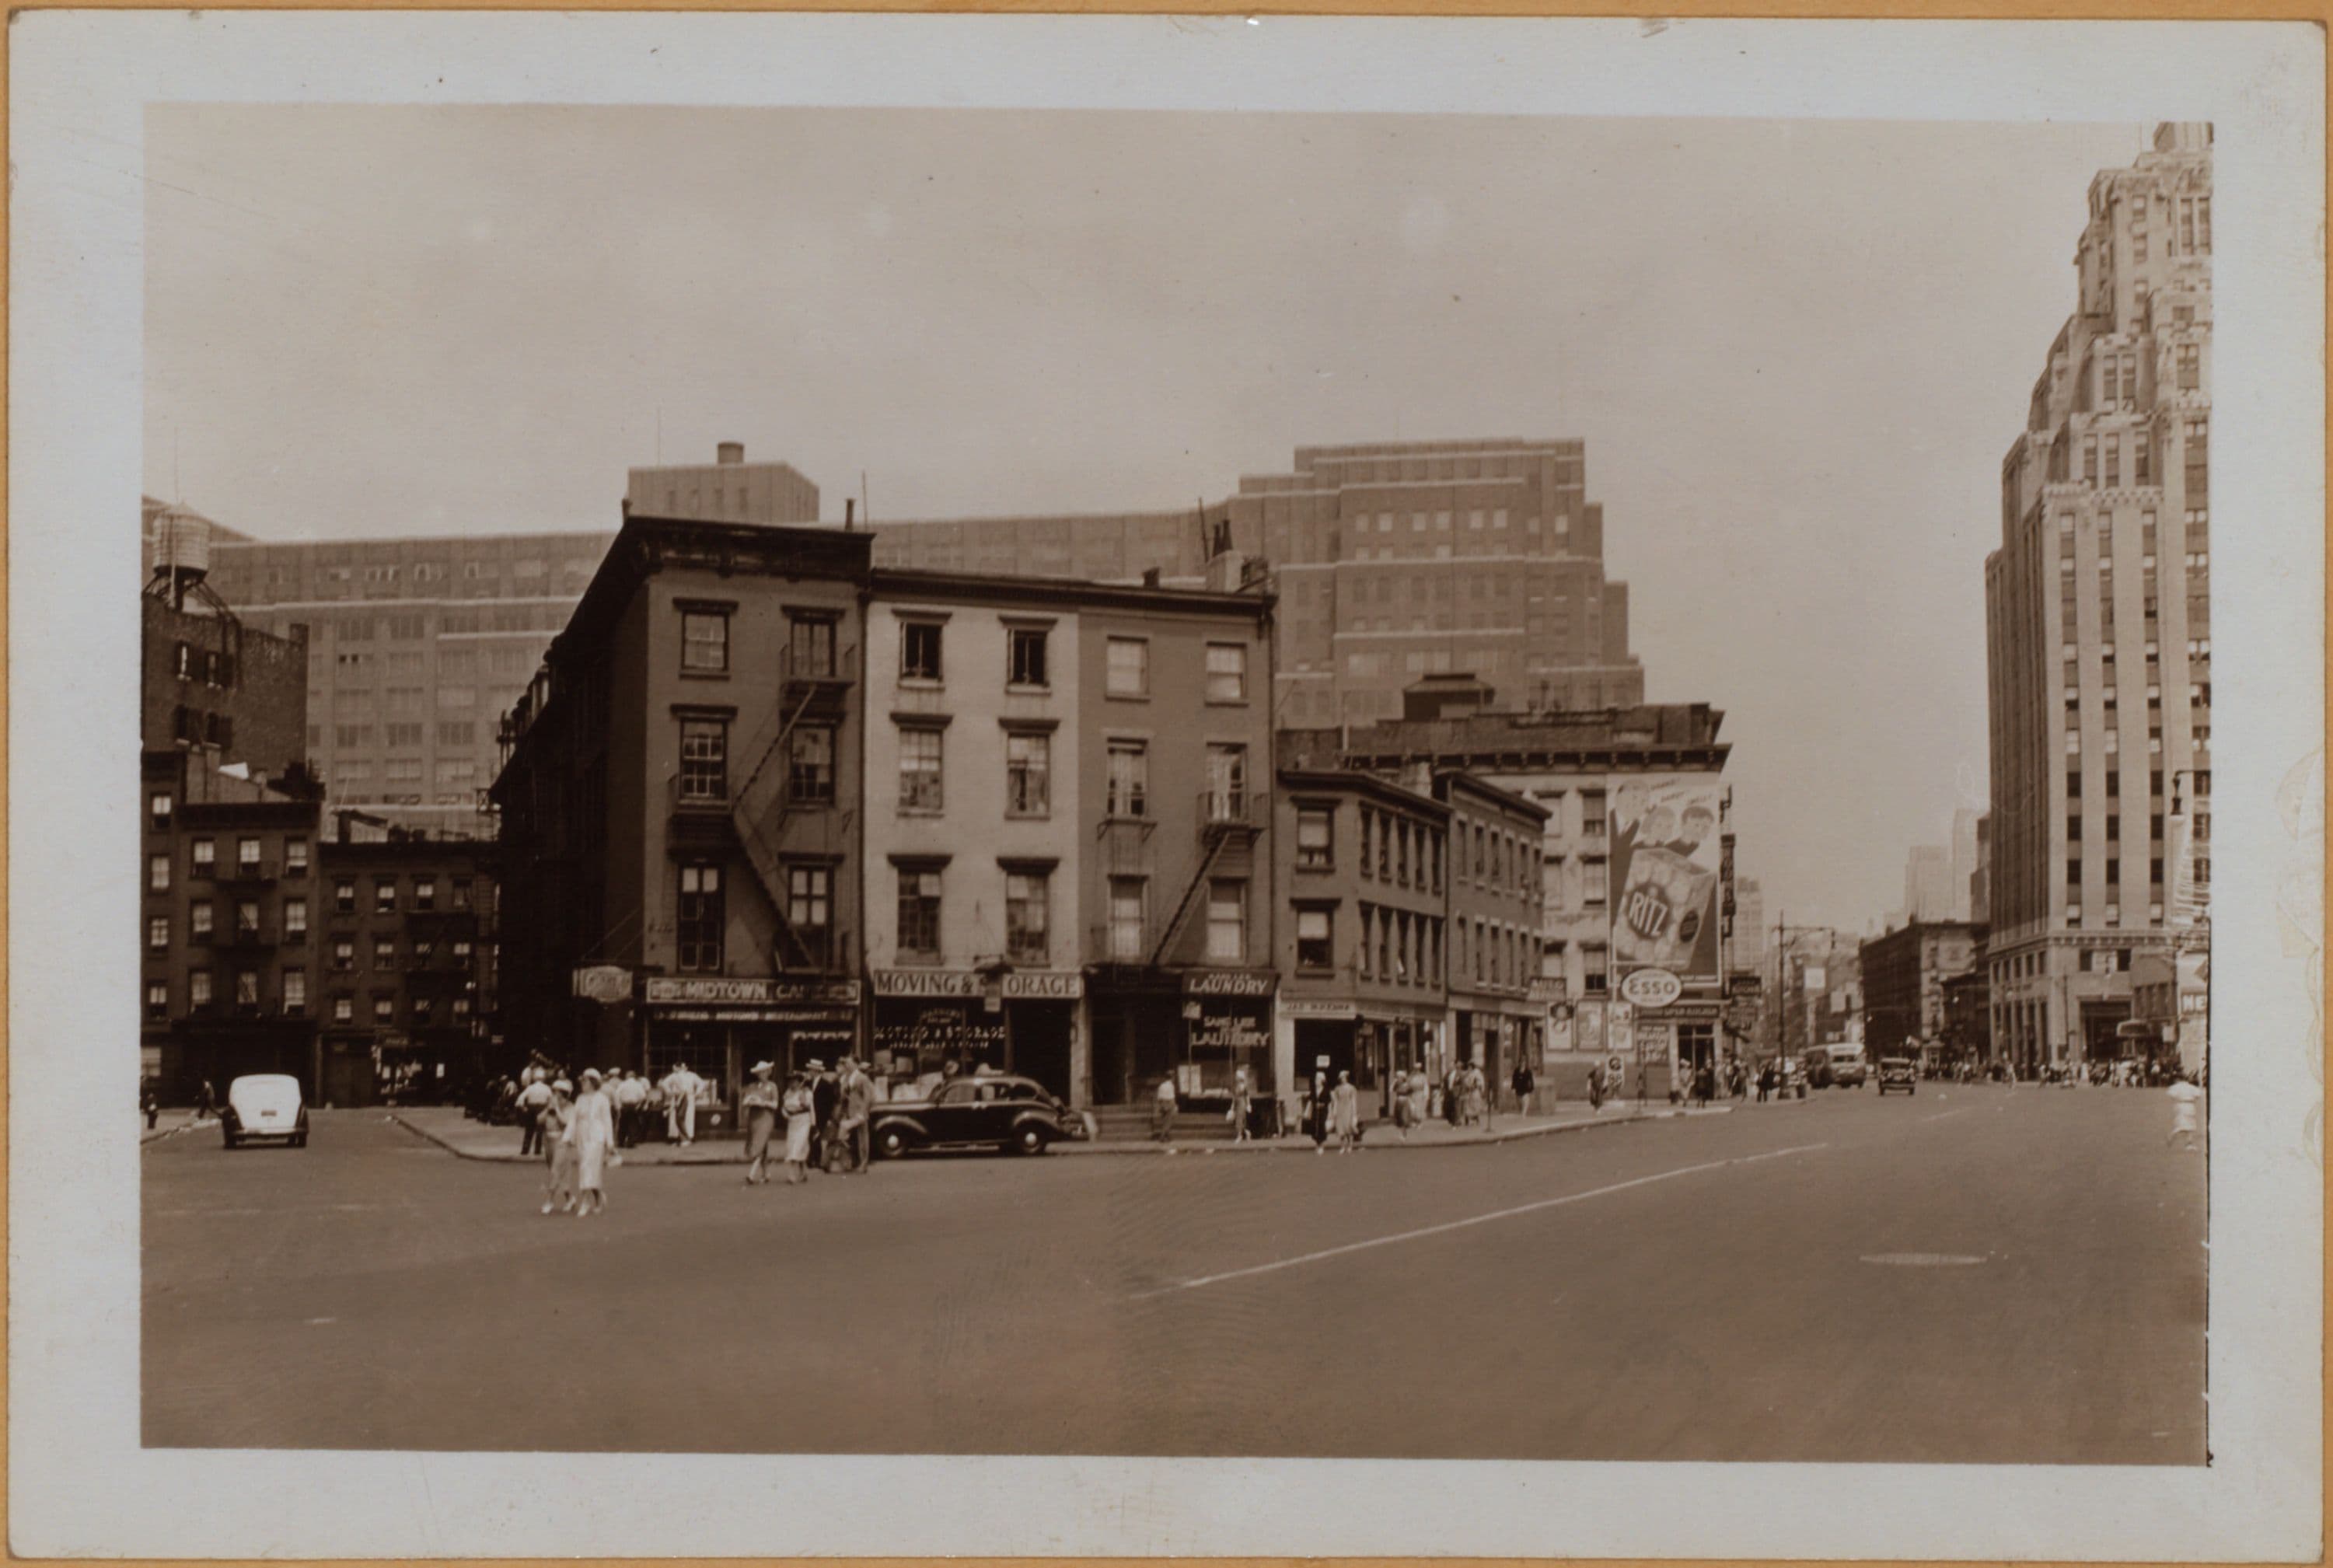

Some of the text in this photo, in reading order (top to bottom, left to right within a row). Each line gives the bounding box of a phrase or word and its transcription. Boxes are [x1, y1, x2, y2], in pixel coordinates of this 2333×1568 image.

[1629, 892, 1668, 937] RITZ
[686, 981, 767, 999] MIDTOWN
[876, 974, 955, 994] MOVING
[961, 975, 973, 994] &
[1189, 979, 1269, 995] LAUNDRY
[946, 1026, 1005, 1039] STORAGE
[1191, 1032, 1270, 1047] LAUNDRY
